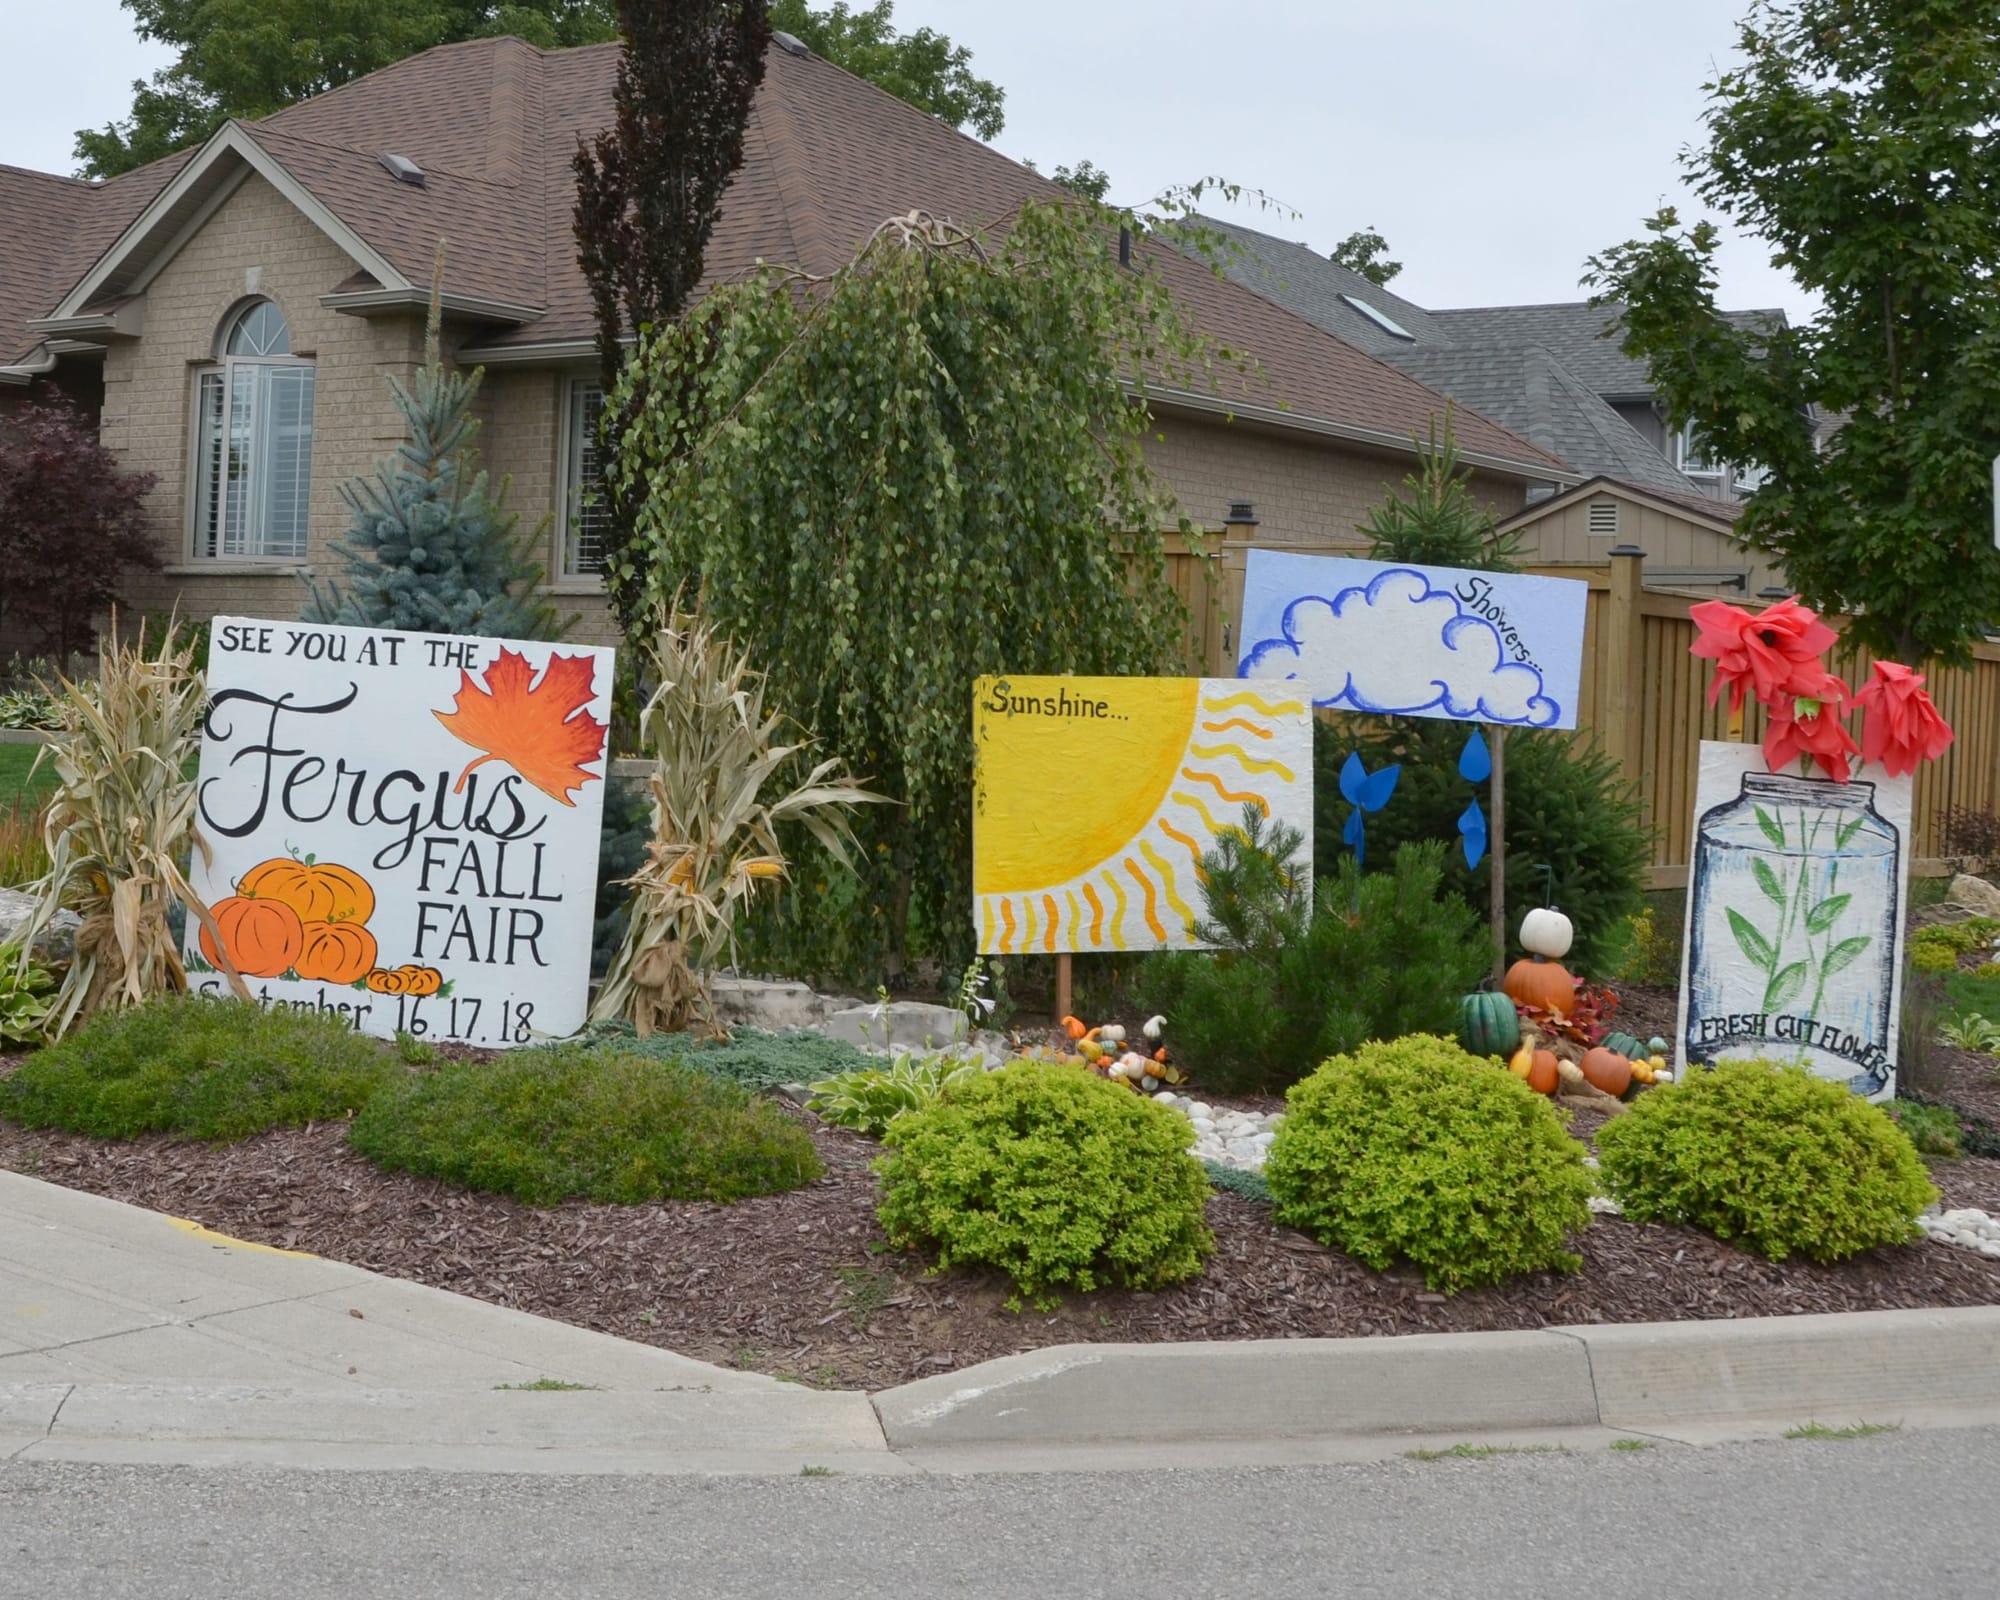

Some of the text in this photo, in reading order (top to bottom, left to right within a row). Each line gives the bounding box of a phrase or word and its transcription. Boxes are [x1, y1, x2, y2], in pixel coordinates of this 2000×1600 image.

[218, 625, 479, 669] SEE YOU AT THE
[199, 681, 548, 870] Fergus
[417, 837, 563, 902] FALL
[412, 902, 549, 967] FAIR
[501, 1001, 535, 1044] 18
[1700, 1014, 1769, 1042] FRESH
[1819, 1026, 1897, 1083] FLOWERS
